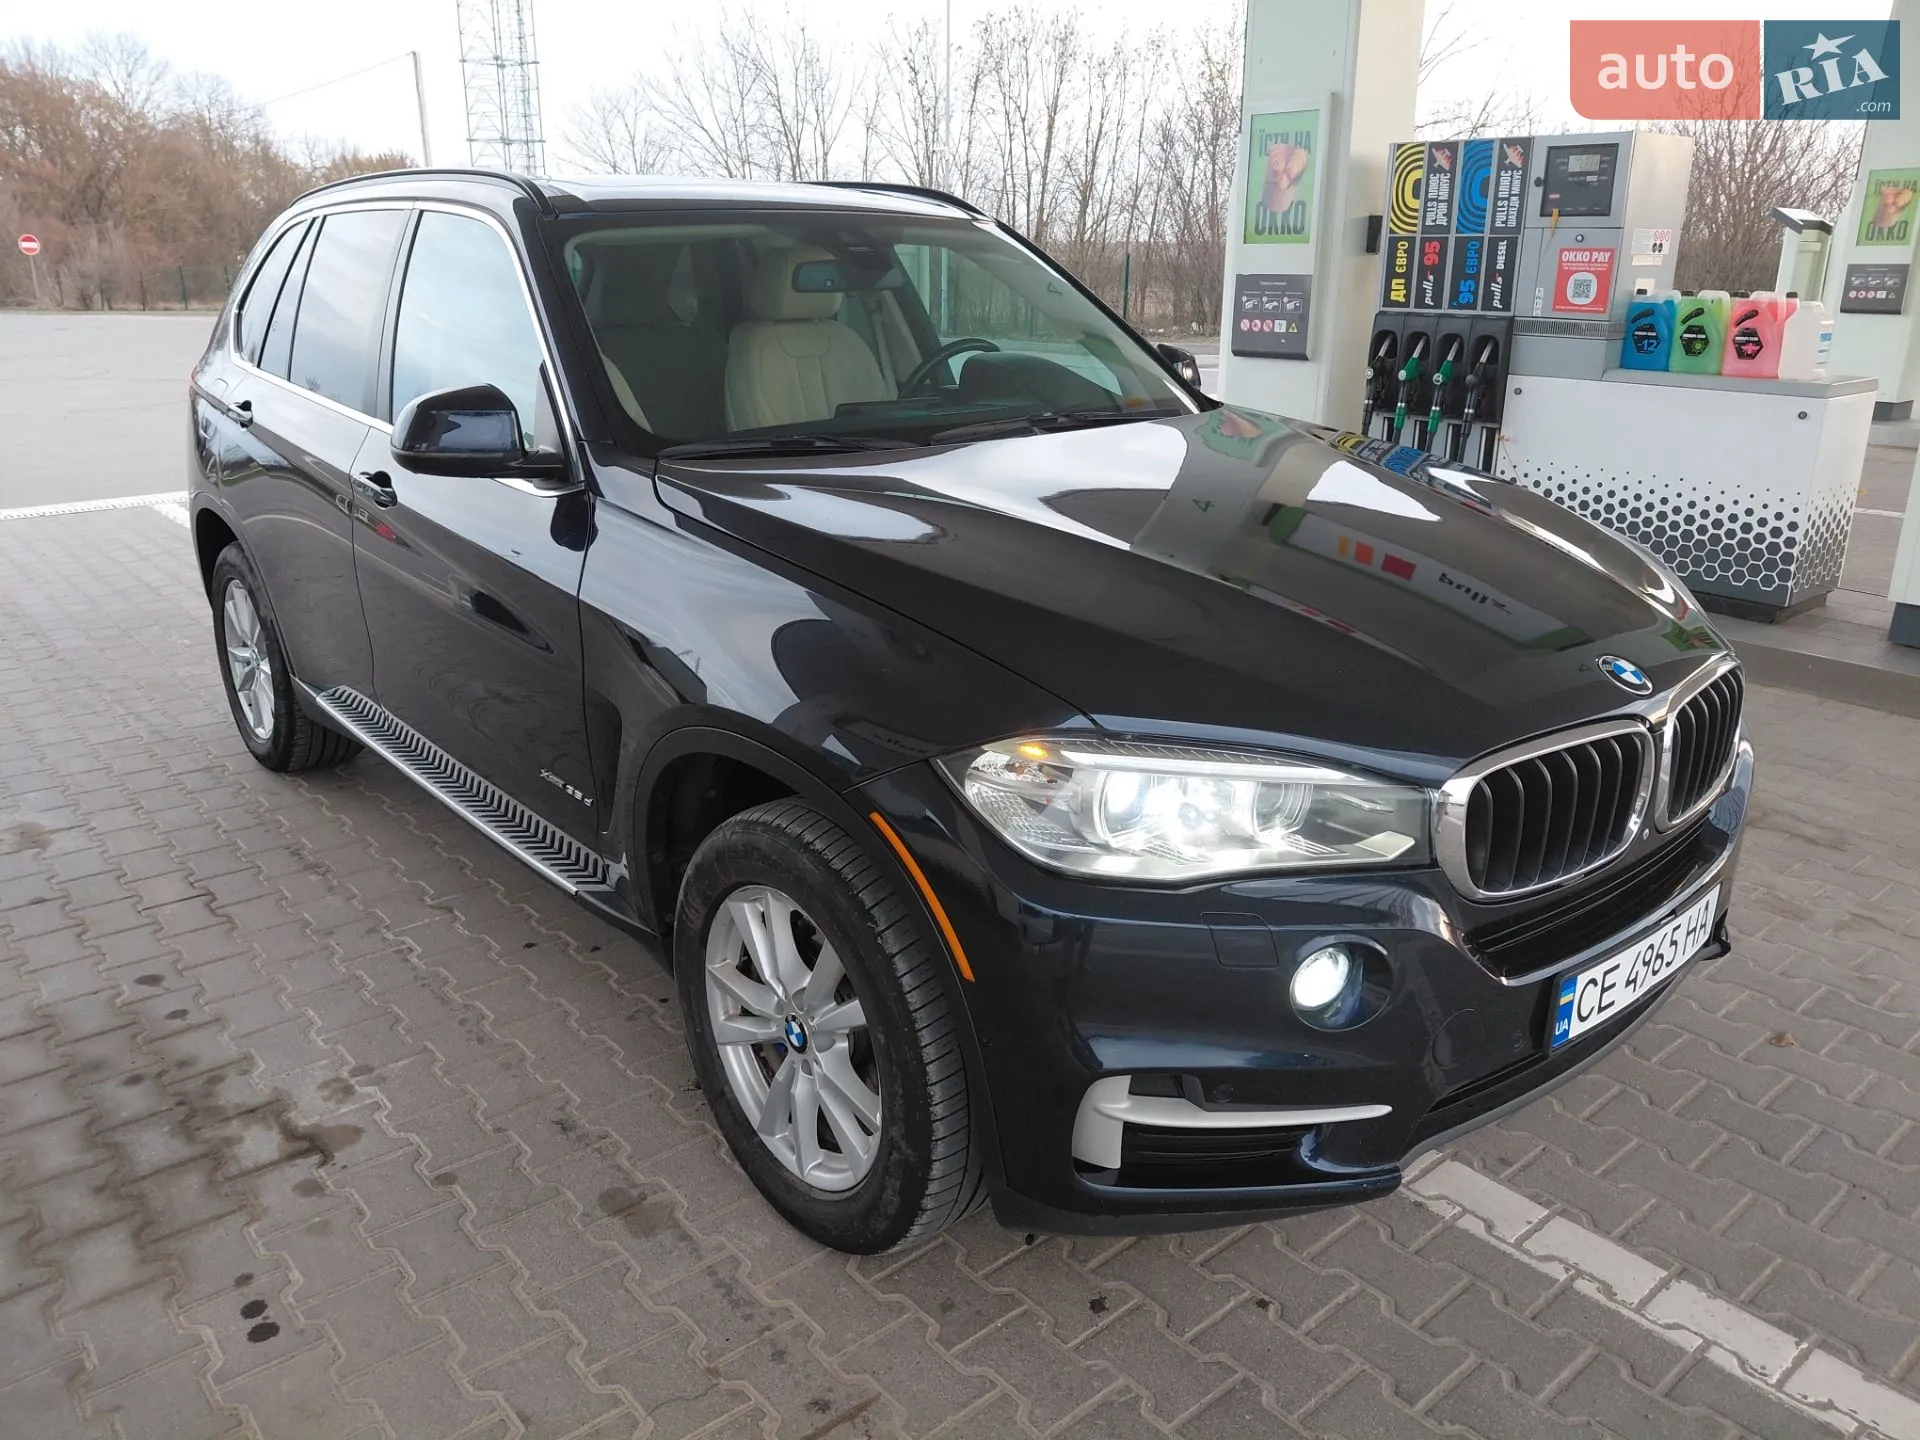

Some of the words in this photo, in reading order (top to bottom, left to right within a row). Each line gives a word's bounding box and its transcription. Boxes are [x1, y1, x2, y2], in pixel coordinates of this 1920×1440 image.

[1425, 201, 1437, 225] PULLS
[1436, 202, 1448, 226] ДРОН
[1495, 201, 1508, 227] PULLS
[1395, 241, 1408, 273] ЄВРО
[1424, 241, 1440, 266] 95
[1465, 240, 1480, 274] ЄВРО
[1496, 240, 1507, 270] DIESEL
[1562, 251, 1590, 262] OKKO
[1592, 251, 1611, 262] PAY
[1390, 279, 1406, 302] ДП
[1459, 280, 1475, 305] 95
[1576, 963, 1621, 1023] CE
[1625, 923, 1682, 994] 4965
[1682, 899, 1710, 956] HA
[1555, 1018, 1569, 1035] UA
